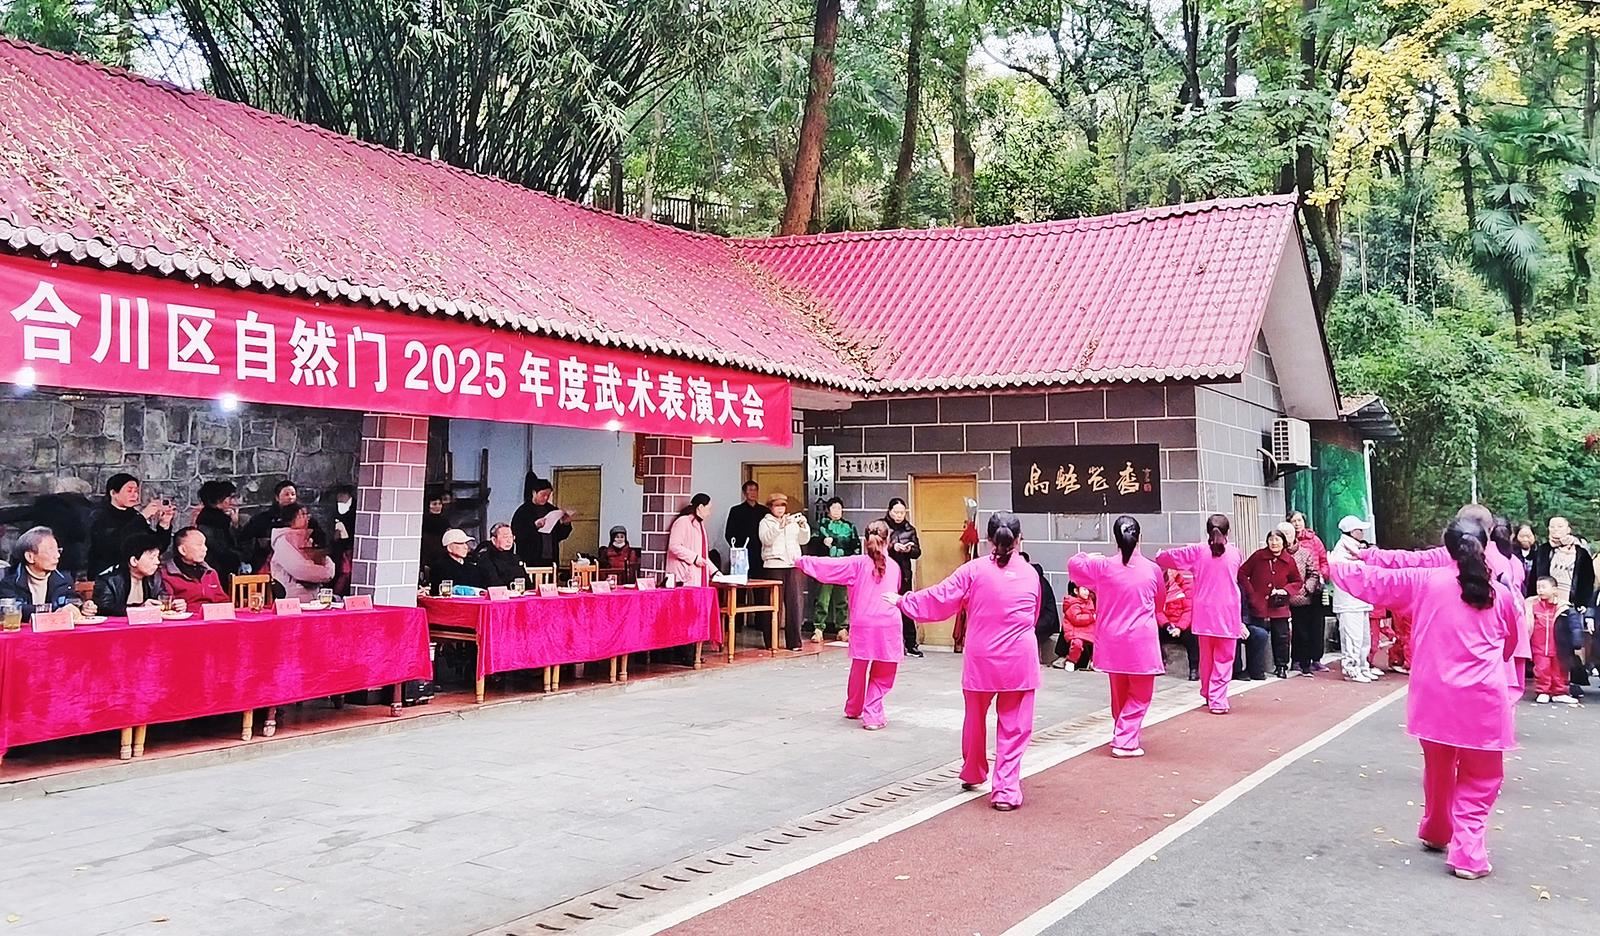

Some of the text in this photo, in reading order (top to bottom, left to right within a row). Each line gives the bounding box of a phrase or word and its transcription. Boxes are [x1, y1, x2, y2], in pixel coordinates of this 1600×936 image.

[10, 280, 765, 430] 合川区自然门 2025 年度武术表演大会
